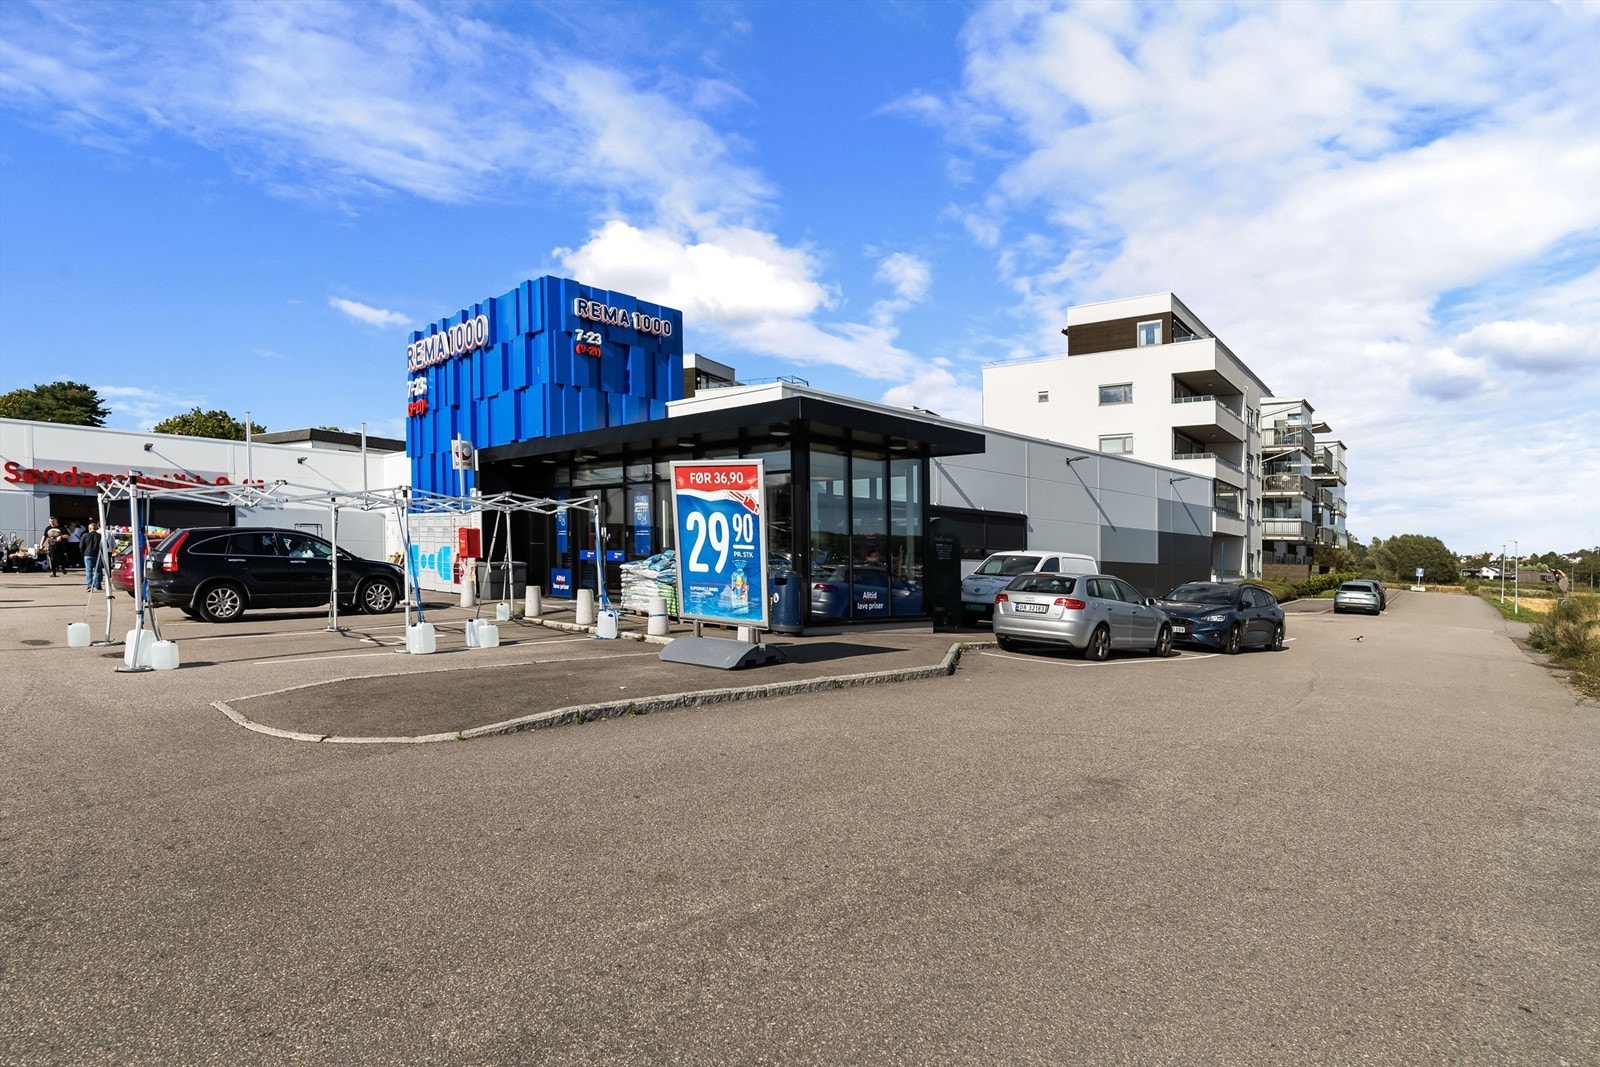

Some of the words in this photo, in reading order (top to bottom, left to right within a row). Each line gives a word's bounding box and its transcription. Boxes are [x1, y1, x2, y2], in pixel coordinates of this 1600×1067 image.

[574, 297, 630, 328] REMA
[632, 312, 672, 337] 1000
[407, 330, 450, 372] REMA
[448, 314, 489, 356] 1000
[575, 329, 602, 345] 7-23
[689, 472, 712, 485] FØR
[714, 471, 744, 485] 36,90
[732, 513, 754, 543] 90
[686, 511, 730, 574] 29
[857, 602, 869, 610] lave
[868, 601, 884, 610] priser
[862, 591, 878, 599] Alltid
